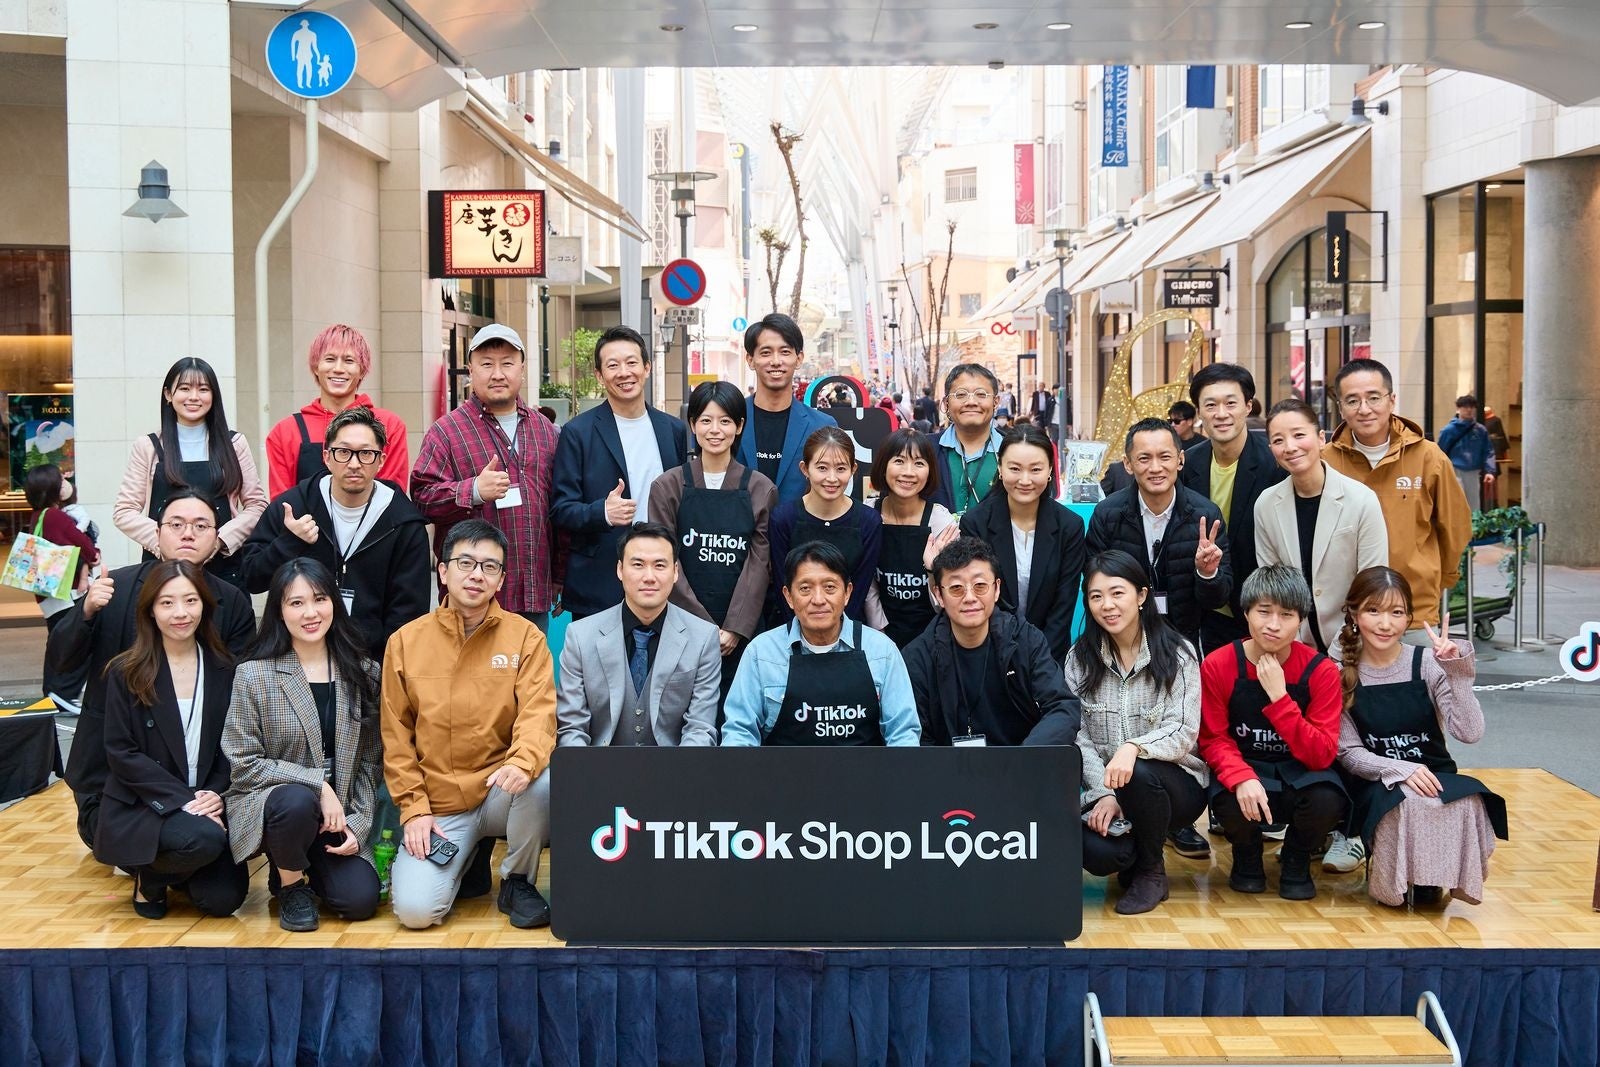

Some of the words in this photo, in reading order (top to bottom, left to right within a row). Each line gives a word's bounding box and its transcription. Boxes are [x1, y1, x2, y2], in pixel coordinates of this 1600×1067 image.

[1116, 117, 1127, 148] Clinic
[1171, 280, 1213, 290] GINCHO
[700, 533, 747, 550] TikTok
[698, 547, 736, 566] Shop
[884, 572, 929, 587] TikTok
[887, 585, 921, 600] Shop
[813, 704, 867, 721] TikTok
[815, 722, 856, 738] Shop
[1380, 732, 1430, 748] TikTok
[645, 821, 793, 860] TikTok
[799, 821, 911, 869] Shop
[921, 821, 1037, 869] Local
